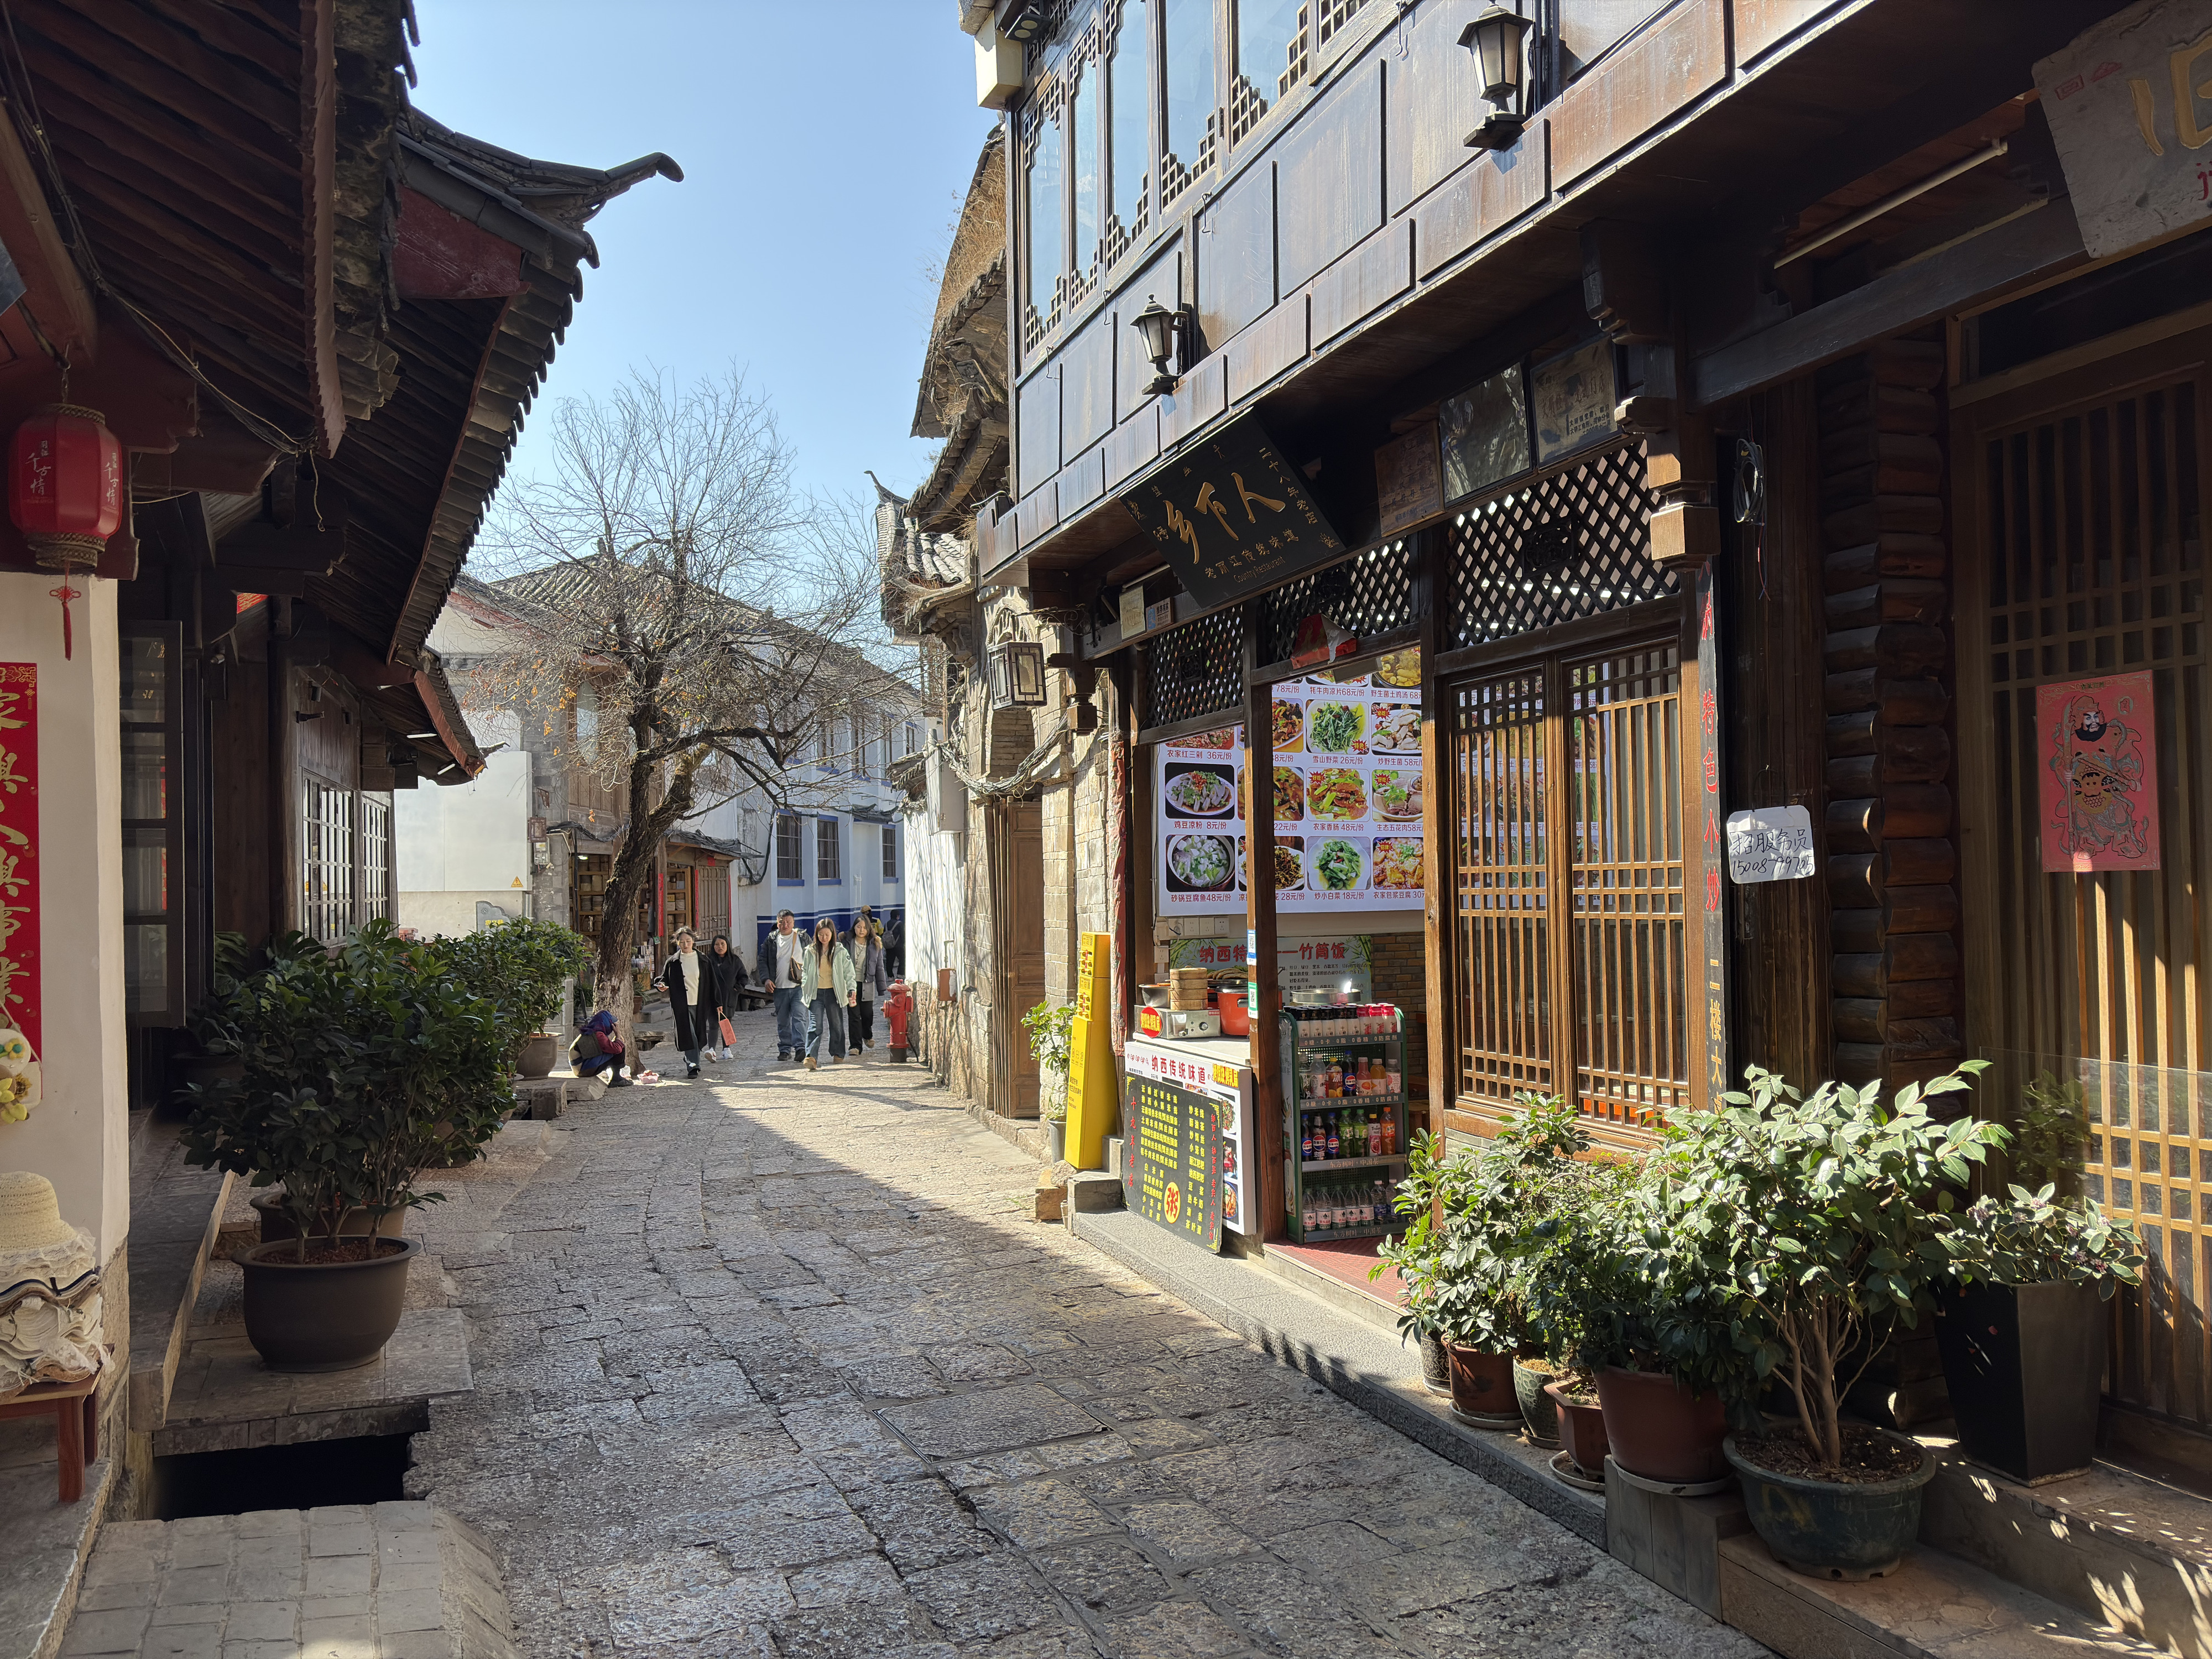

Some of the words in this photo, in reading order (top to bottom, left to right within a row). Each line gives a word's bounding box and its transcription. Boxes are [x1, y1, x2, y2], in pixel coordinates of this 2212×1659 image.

[25, 452, 51, 495] 千古情
[1259, 447, 1318, 524] 二十八年老店
[1162, 472, 1286, 565] 乡下人
[1204, 529, 1299, 579] 老丽江传统味道
[1233, 568, 1257, 583] Country
[1254, 556, 1286, 574] Restaurant
[1310, 686, 1365, 697] 牦牛肉凉片68元/份
[1370, 690, 1408, 699] 野生菌土鸡汤
[1167, 750, 1203, 759] 农家红三剁
[1207, 752, 1232, 760] 36元/份
[1312, 755, 1339, 764] 雪山野菜
[1340, 756, 1363, 765] 26元/份
[1702, 688, 1720, 912] 特色小炒
[1174, 821, 1202, 830] 鸡豆凉粉
[1207, 821, 1227, 830] 8元/份
[1313, 823, 1339, 832] 农家香肠
[1340, 823, 1364, 832] 48元/份
[1376, 824, 1423, 832] 生态五花肉58元/
[1732, 828, 1813, 857] 招服务员
[1732, 855, 1814, 877] 15008799705
[1171, 894, 1231, 902] 砂锅豆腐鱼48元/份
[1281, 892, 1305, 901] 28元/份
[1314, 891, 1340, 900] 炒小白菜
[1343, 891, 1364, 900] 18元/份
[1373, 891, 1411, 899] 农家包浆豆腐
[1151, 1054, 1206, 1084] 纳西传统味道
[1127, 1096, 1136, 1187] 十九年老店
[1166, 1187, 1178, 1219] 粥
